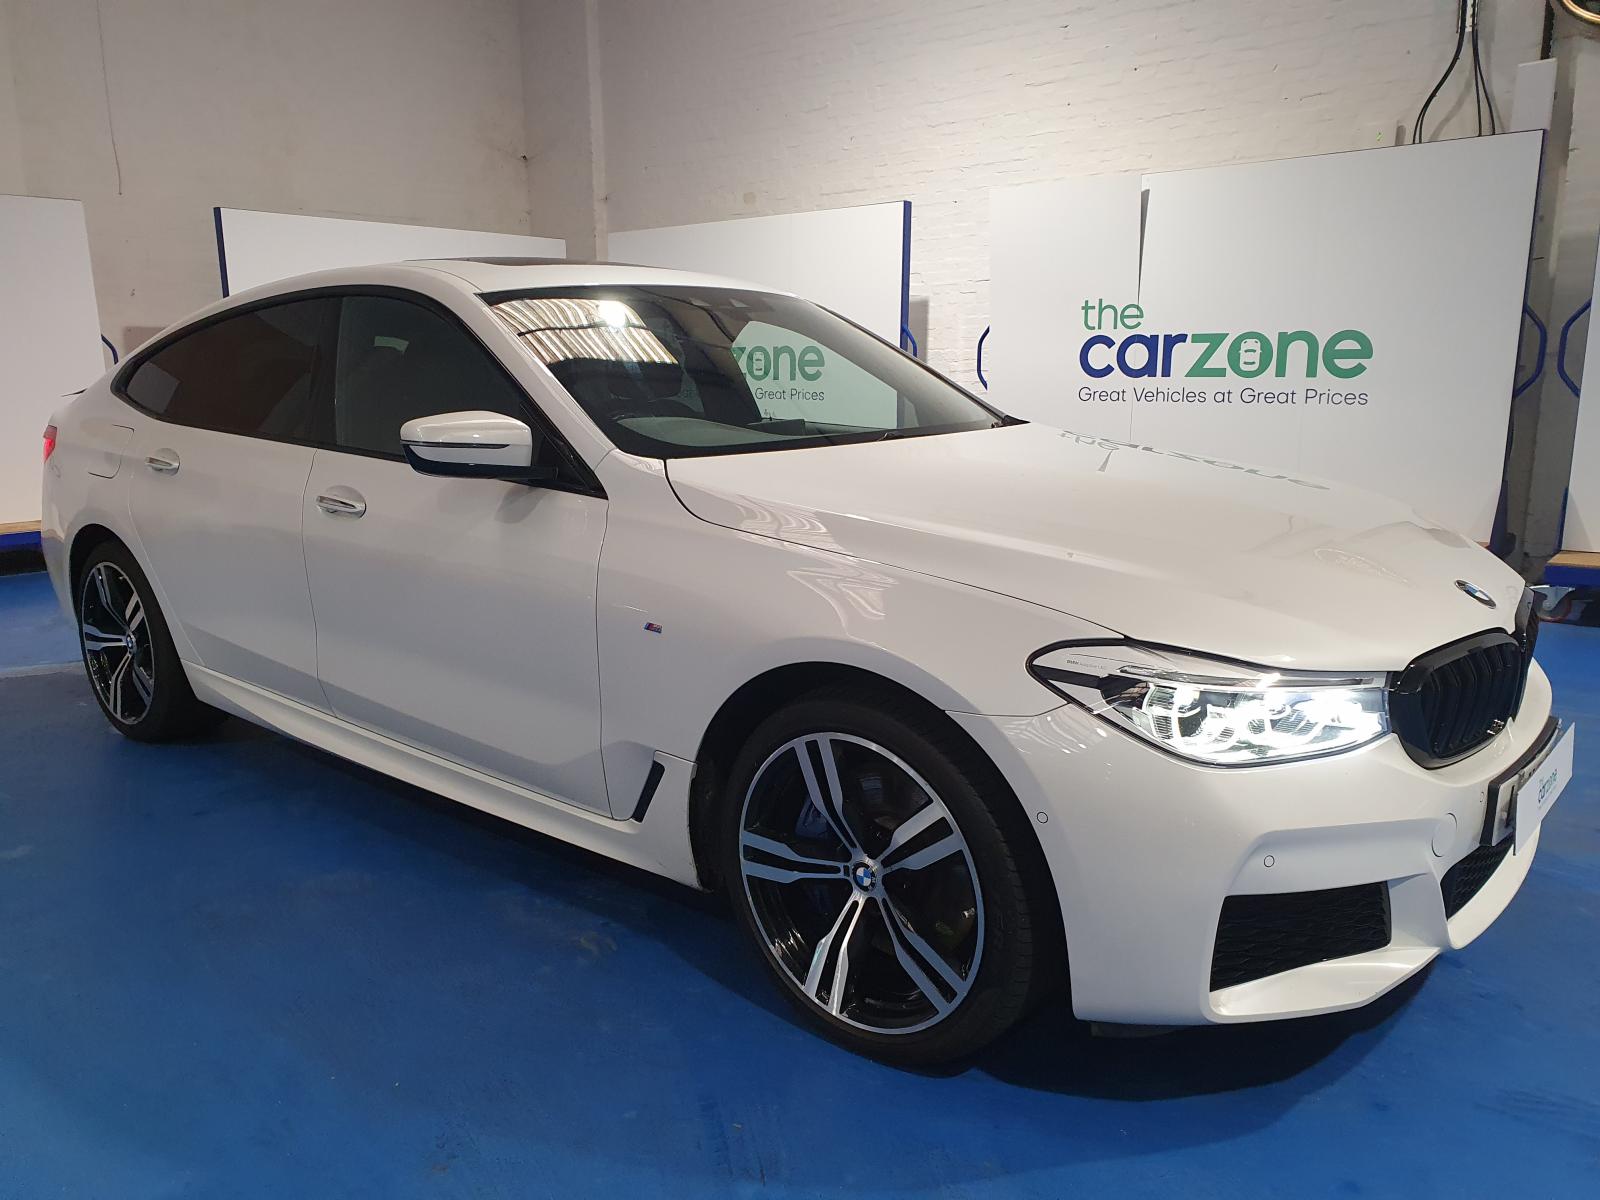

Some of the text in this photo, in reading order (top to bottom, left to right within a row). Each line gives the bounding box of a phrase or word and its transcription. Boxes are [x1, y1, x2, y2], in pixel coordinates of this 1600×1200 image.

[1081, 298, 1144, 330] the
[1079, 329, 1374, 379] carzone
[754, 387, 825, 401] Great Prices
[1077, 386, 1369, 406] Great Vehicles at Great Prices
